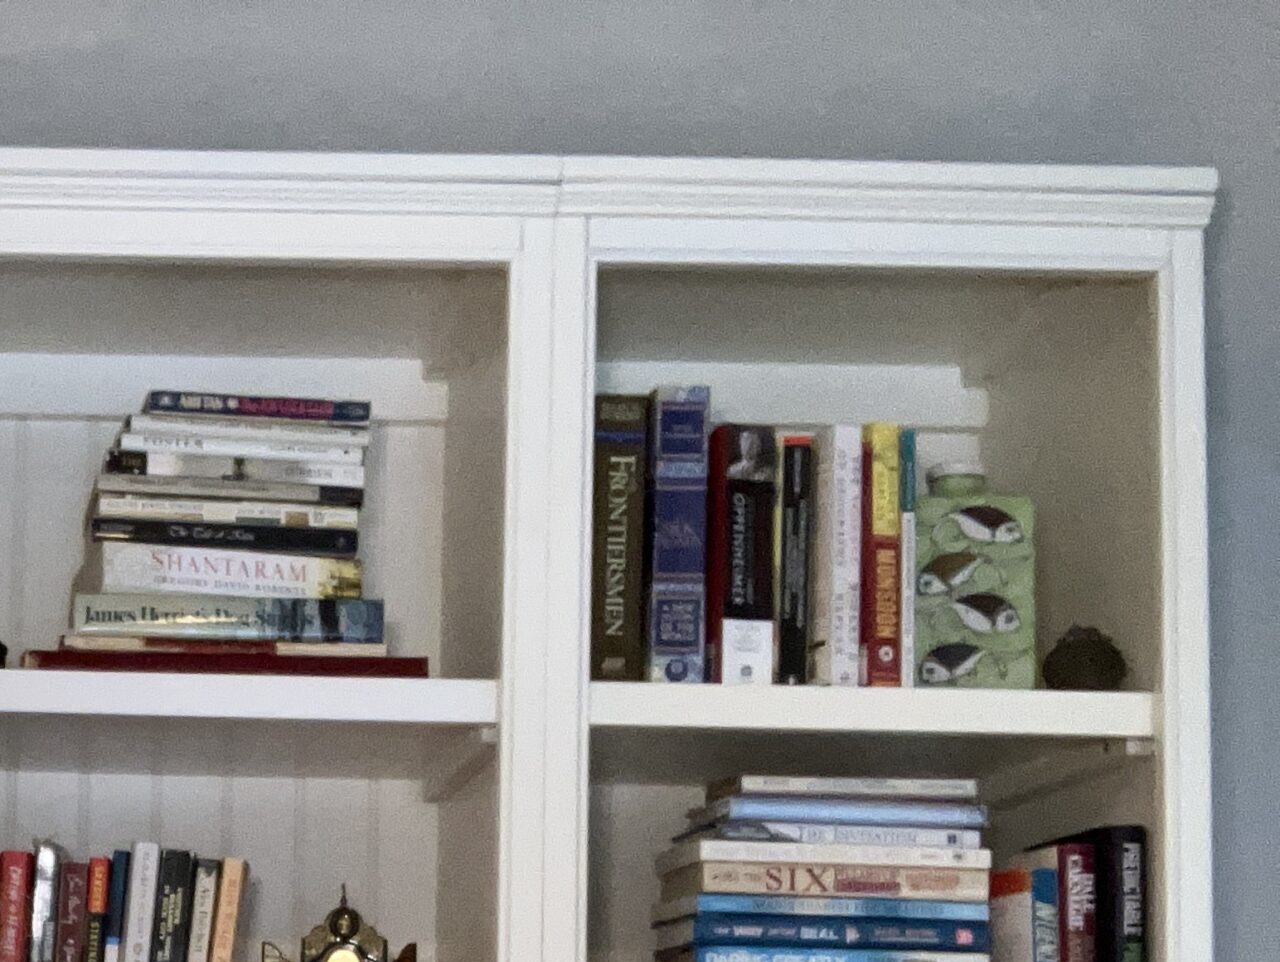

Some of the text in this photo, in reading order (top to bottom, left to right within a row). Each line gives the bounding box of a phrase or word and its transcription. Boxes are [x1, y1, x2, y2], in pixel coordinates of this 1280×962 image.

[151, 549, 307, 583] SHANTARAM
[731, 493, 747, 606] OPPENHEIMER
[85, 605, 136, 624] James
[874, 549, 898, 640] MONSOON
[765, 865, 832, 893] SIX
[1067, 854, 1084, 932] CARNEGIE
[1123, 843, 1142, 937] PREDICTABLE
